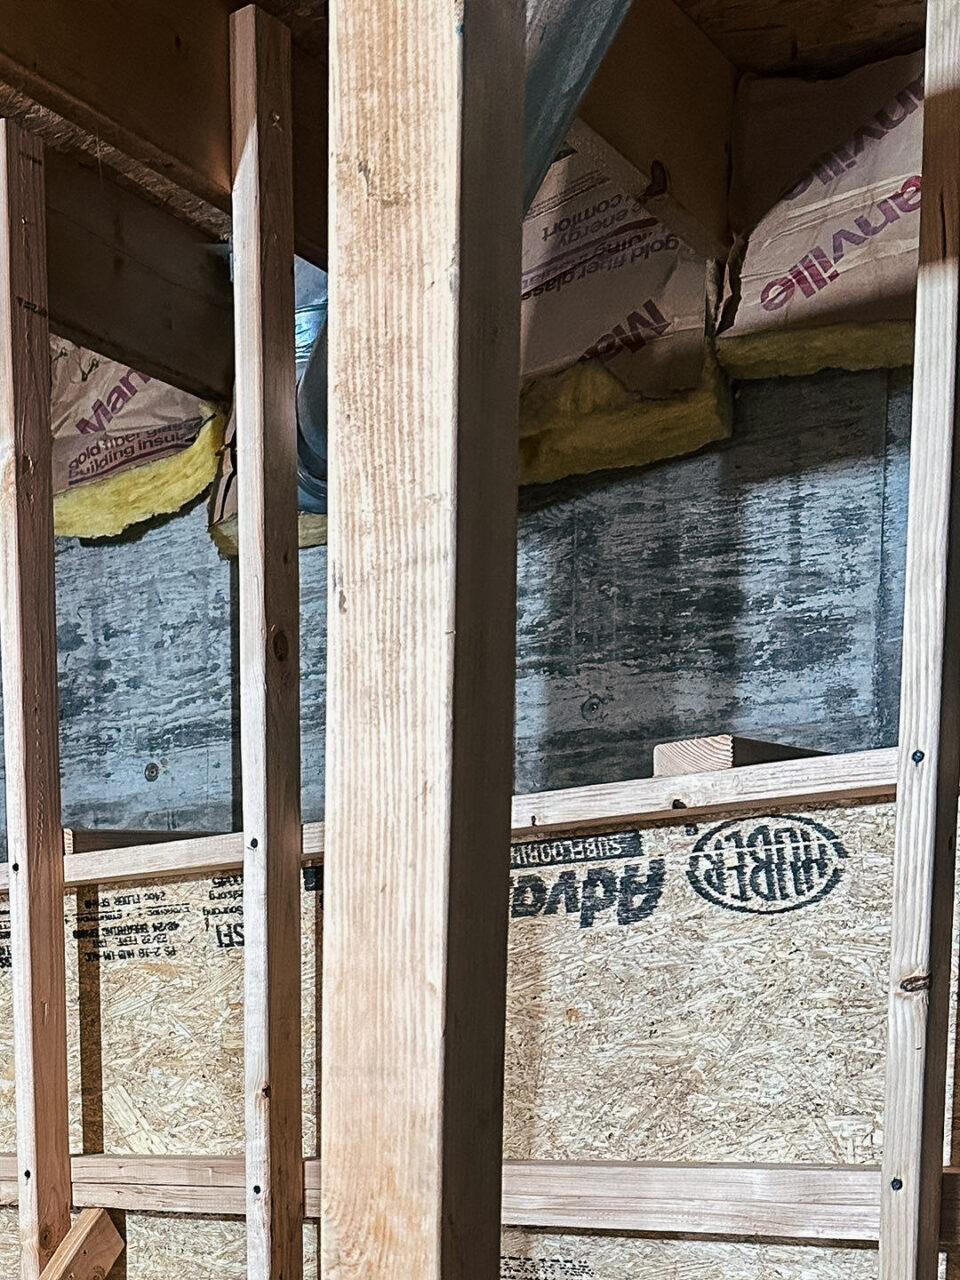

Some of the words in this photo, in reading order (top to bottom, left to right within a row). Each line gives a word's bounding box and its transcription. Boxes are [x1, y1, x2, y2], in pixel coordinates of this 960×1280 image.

[541, 193, 623, 242] comfort
[557, 209, 629, 249] energy
[631, 234, 680, 265] gold
[760, 175, 922, 312] anville
[578, 299, 672, 362] Ma
[76, 368, 151, 434] Man
[68, 446, 135, 479] building
[69, 440, 102, 470] gold
[511, 838, 622, 866] SUBFLOORIN
[511, 857, 665, 928] Adva
[164, 946, 177, 957] PS
